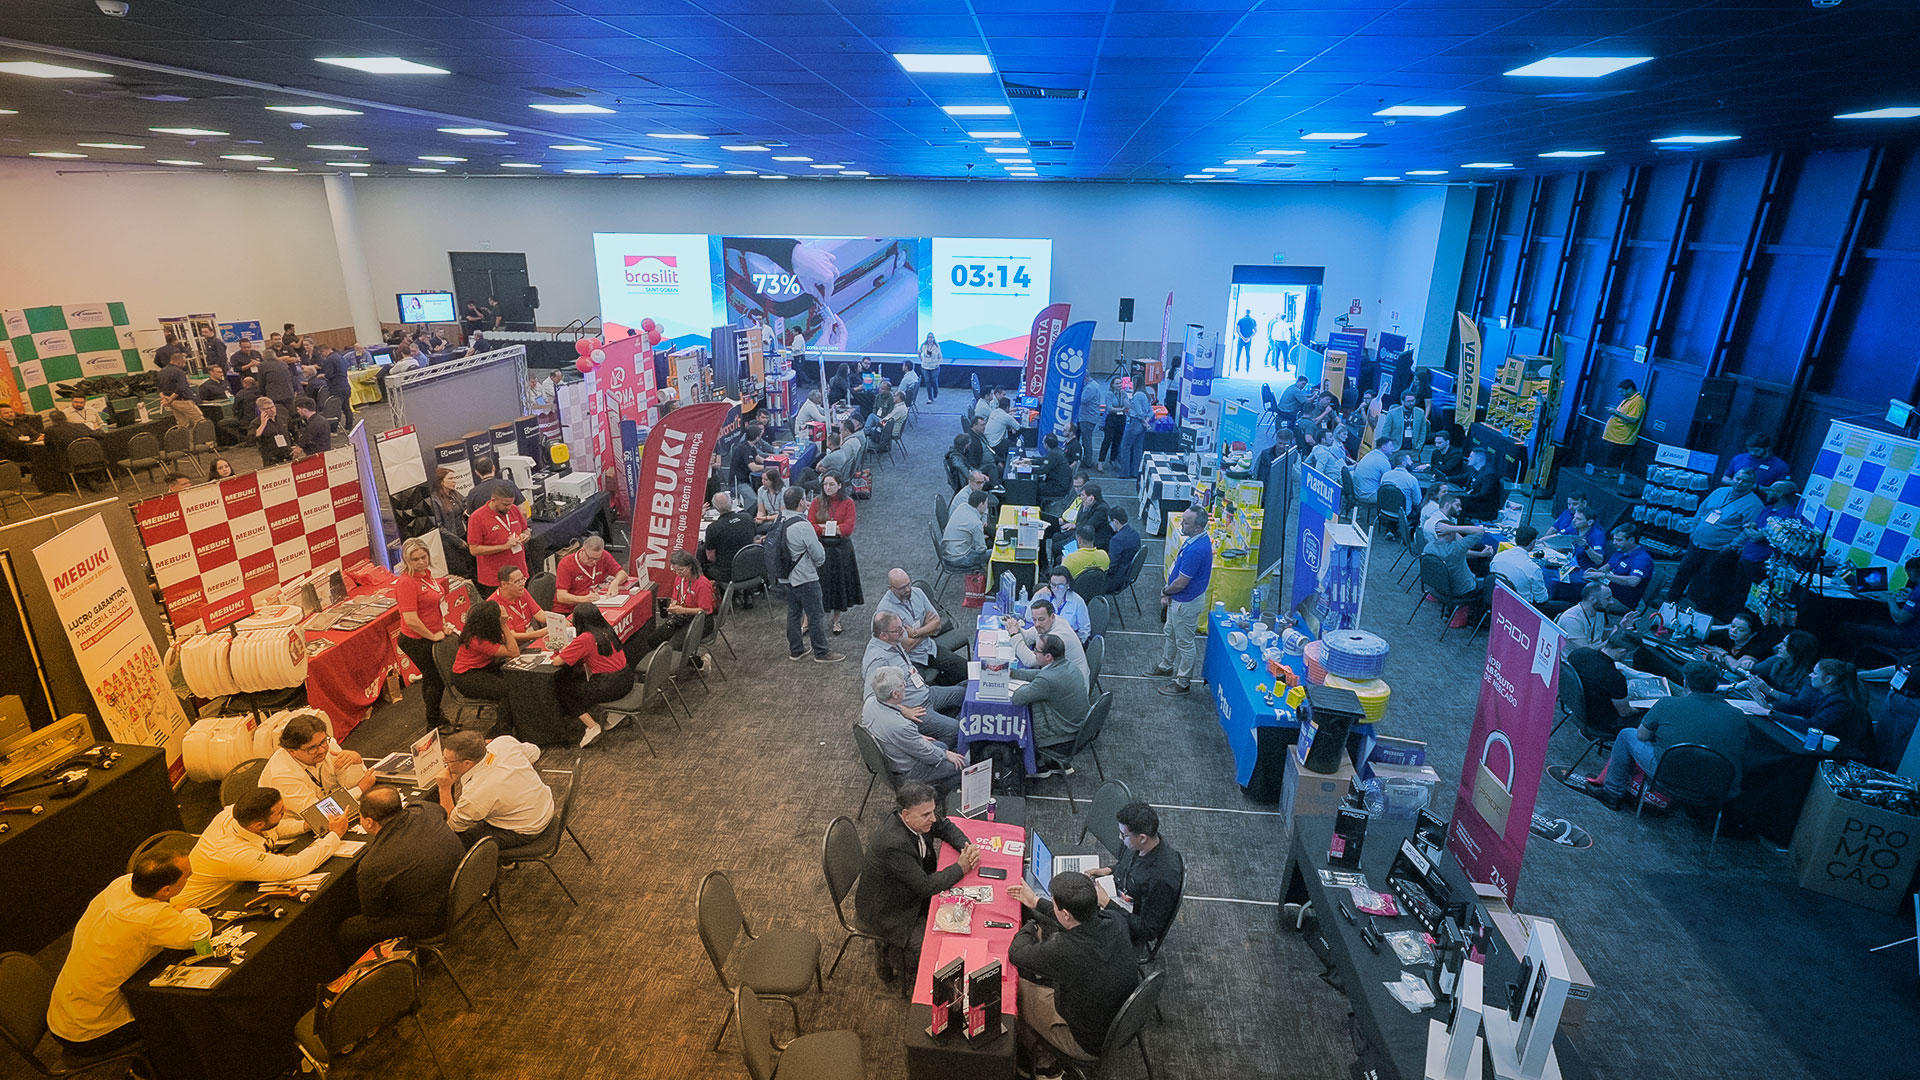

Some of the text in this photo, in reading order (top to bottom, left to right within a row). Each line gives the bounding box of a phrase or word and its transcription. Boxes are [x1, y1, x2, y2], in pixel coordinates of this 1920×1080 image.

[625, 269, 679, 284] brasilit
[752, 273, 800, 295] 73%
[951, 264, 1031, 288] 03:14
[1034, 318, 1050, 371] TOYOTA
[1463, 341, 1476, 412] VEDACIT
[1051, 378, 1077, 447] TIGRE
[685, 431, 704, 475] diferença.
[225, 487, 256, 501] MEBUKI
[262, 478, 290, 491] MEBUKI
[186, 498, 220, 514] MEBUKI
[646, 428, 688, 570] MEBUKI
[679, 485, 692, 514] fazem
[142, 510, 180, 527] MEBUKI
[678, 517, 688, 532] que
[235, 525, 266, 540] MEBUKI
[197, 538, 230, 554] MEBUKI
[279, 550, 306, 564] MEBUKI
[53, 547, 110, 593] MEBUKI
[155, 551, 191, 568] MEBUKI
[207, 576, 239, 593] MEBUKI
[67, 609, 93, 631] LUCRO
[93, 586, 128, 615] GARANTIDO,
[168, 591, 202, 609] MEBUKI
[209, 600, 245, 620] MEBUKI
[75, 613, 108, 639] PARCERIA
[612, 612, 633, 634] BUKI
[1496, 612, 1531, 650] PADO
[1541, 638, 1553, 659] 15
[1484, 673, 1518, 708] DE MERCADO
[1486, 664, 1515, 693] ABSOLUTO
[1842, 817, 1909, 849] PRO
[1406, 845, 1426, 870] PADO
[1834, 836, 1900, 869] MO
[1826, 861, 1890, 890] ÇÃO
